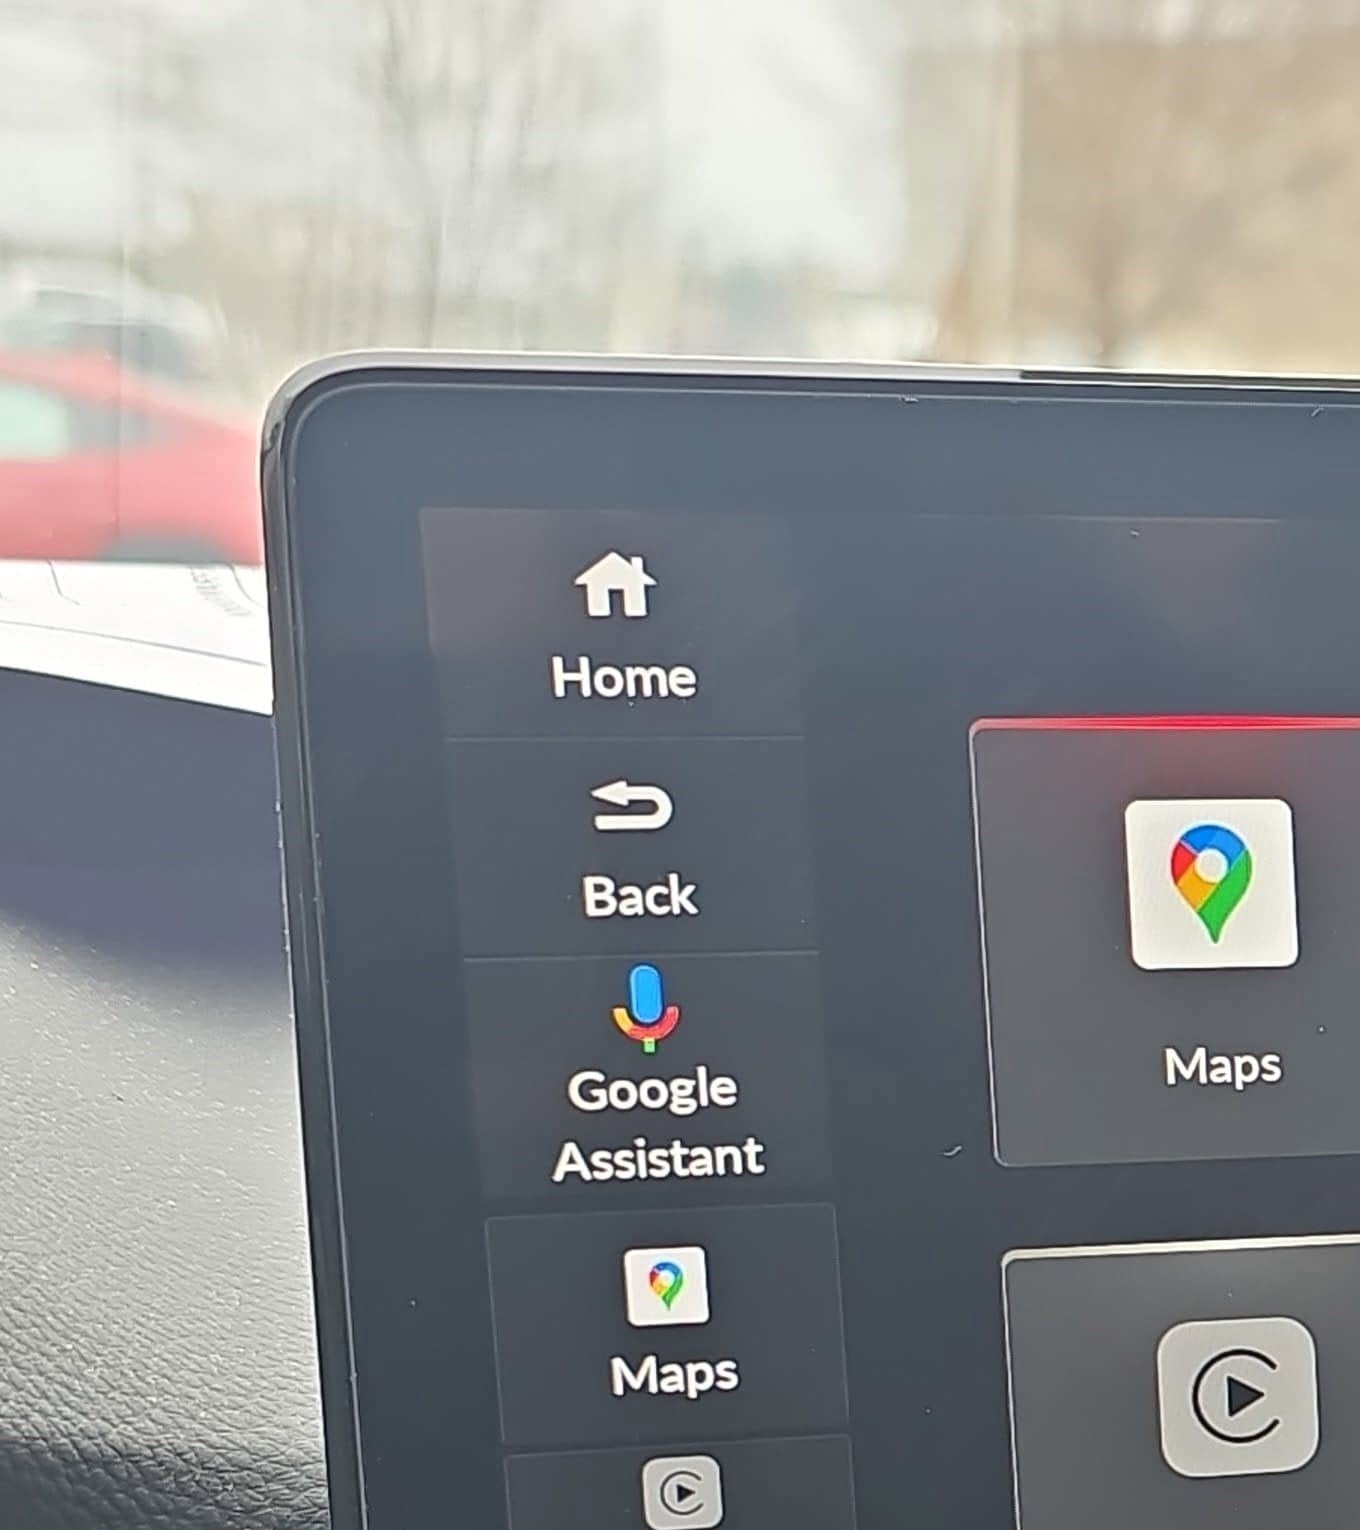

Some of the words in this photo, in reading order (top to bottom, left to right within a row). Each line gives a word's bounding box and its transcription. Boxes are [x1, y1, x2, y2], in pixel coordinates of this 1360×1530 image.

[552, 656, 697, 699] Home
[583, 873, 699, 918] Back
[567, 1065, 738, 1115] Google
[1164, 1046, 1283, 1091] Maps
[551, 1136, 765, 1182] Assistant
[610, 1354, 740, 1400] Maps
